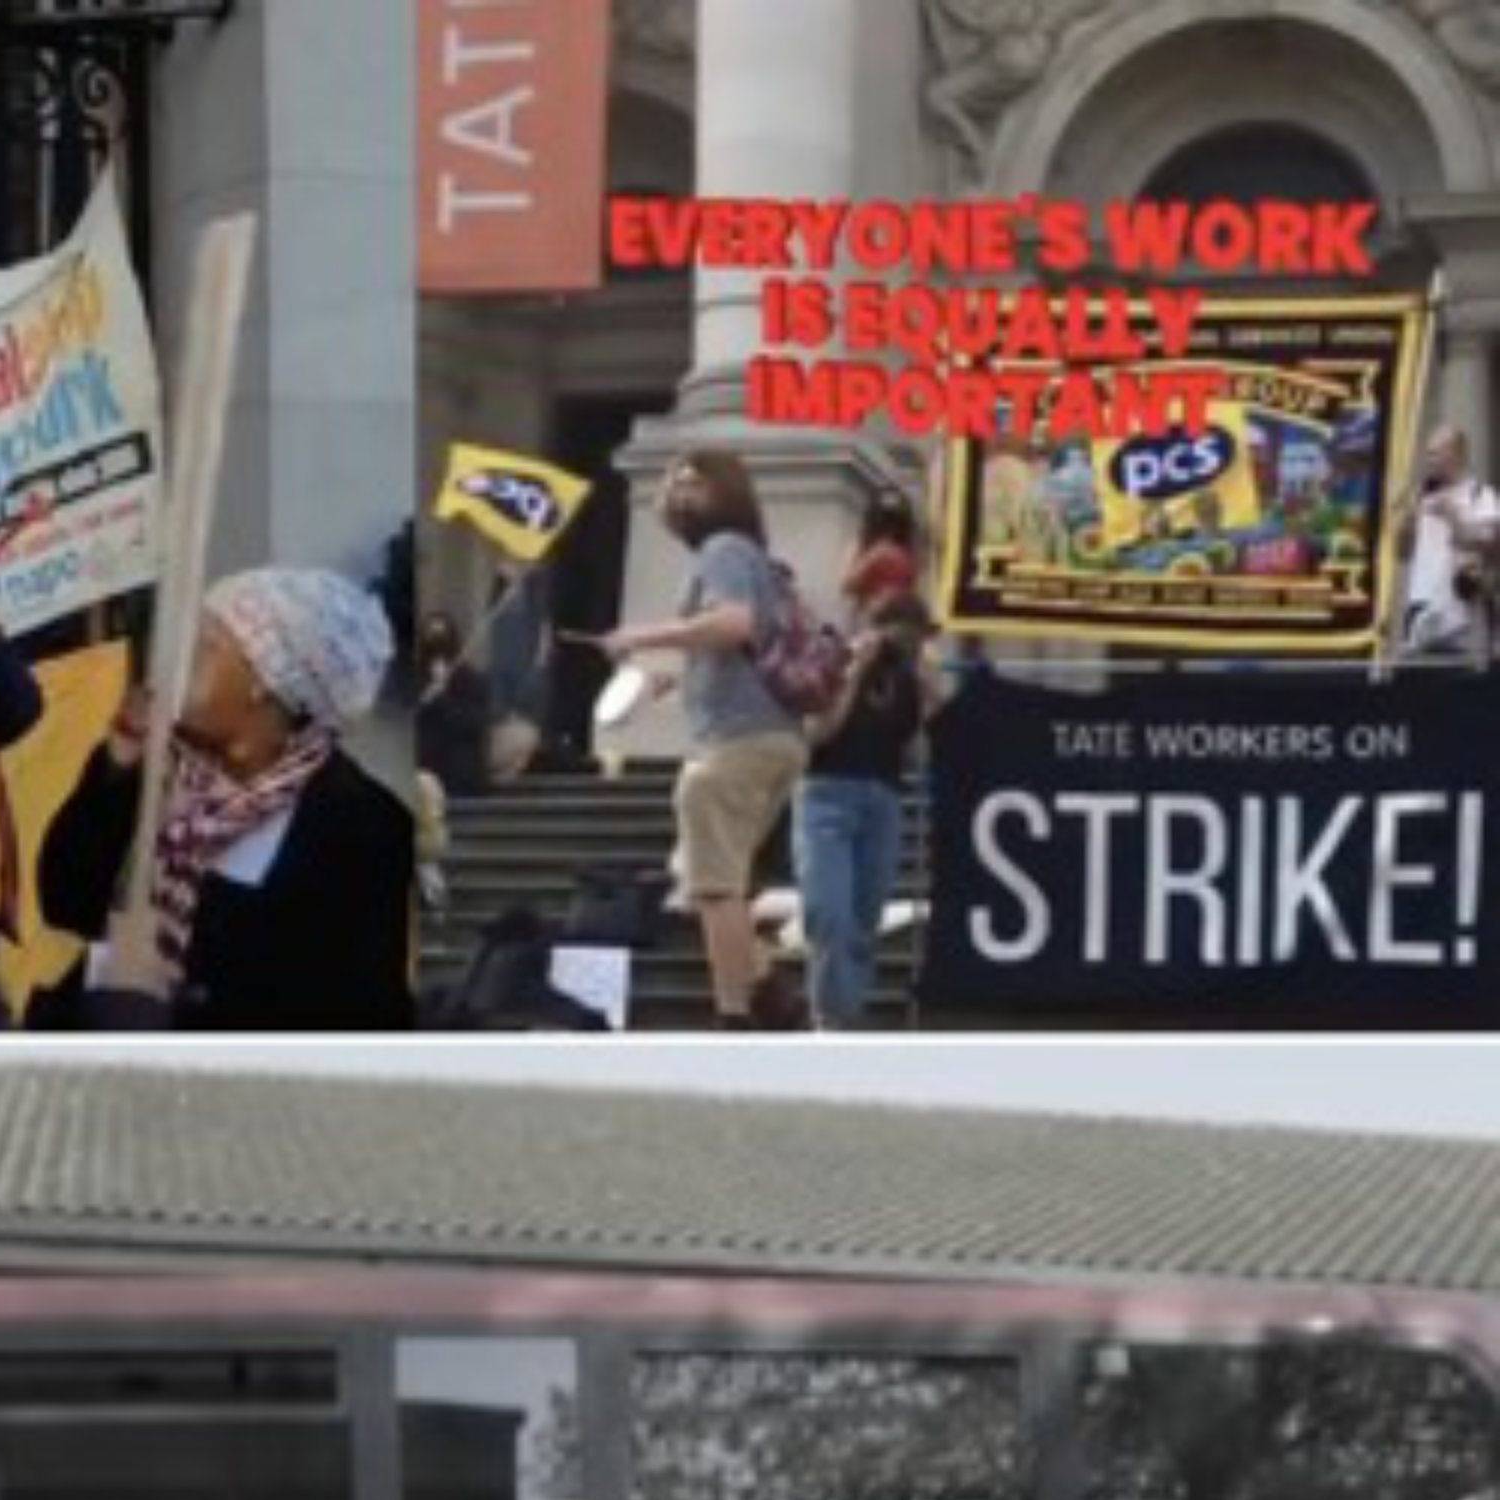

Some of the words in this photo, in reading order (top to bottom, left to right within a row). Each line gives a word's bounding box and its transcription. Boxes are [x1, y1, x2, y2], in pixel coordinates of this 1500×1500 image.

[438, 0, 536, 235] TAT
[1122, 433, 1222, 498] pcs
[1050, 721, 1134, 759] TATE
[1145, 721, 1333, 759] WORKERS
[1344, 721, 1410, 759] ON
[968, 789, 1485, 968] STRIKE!
